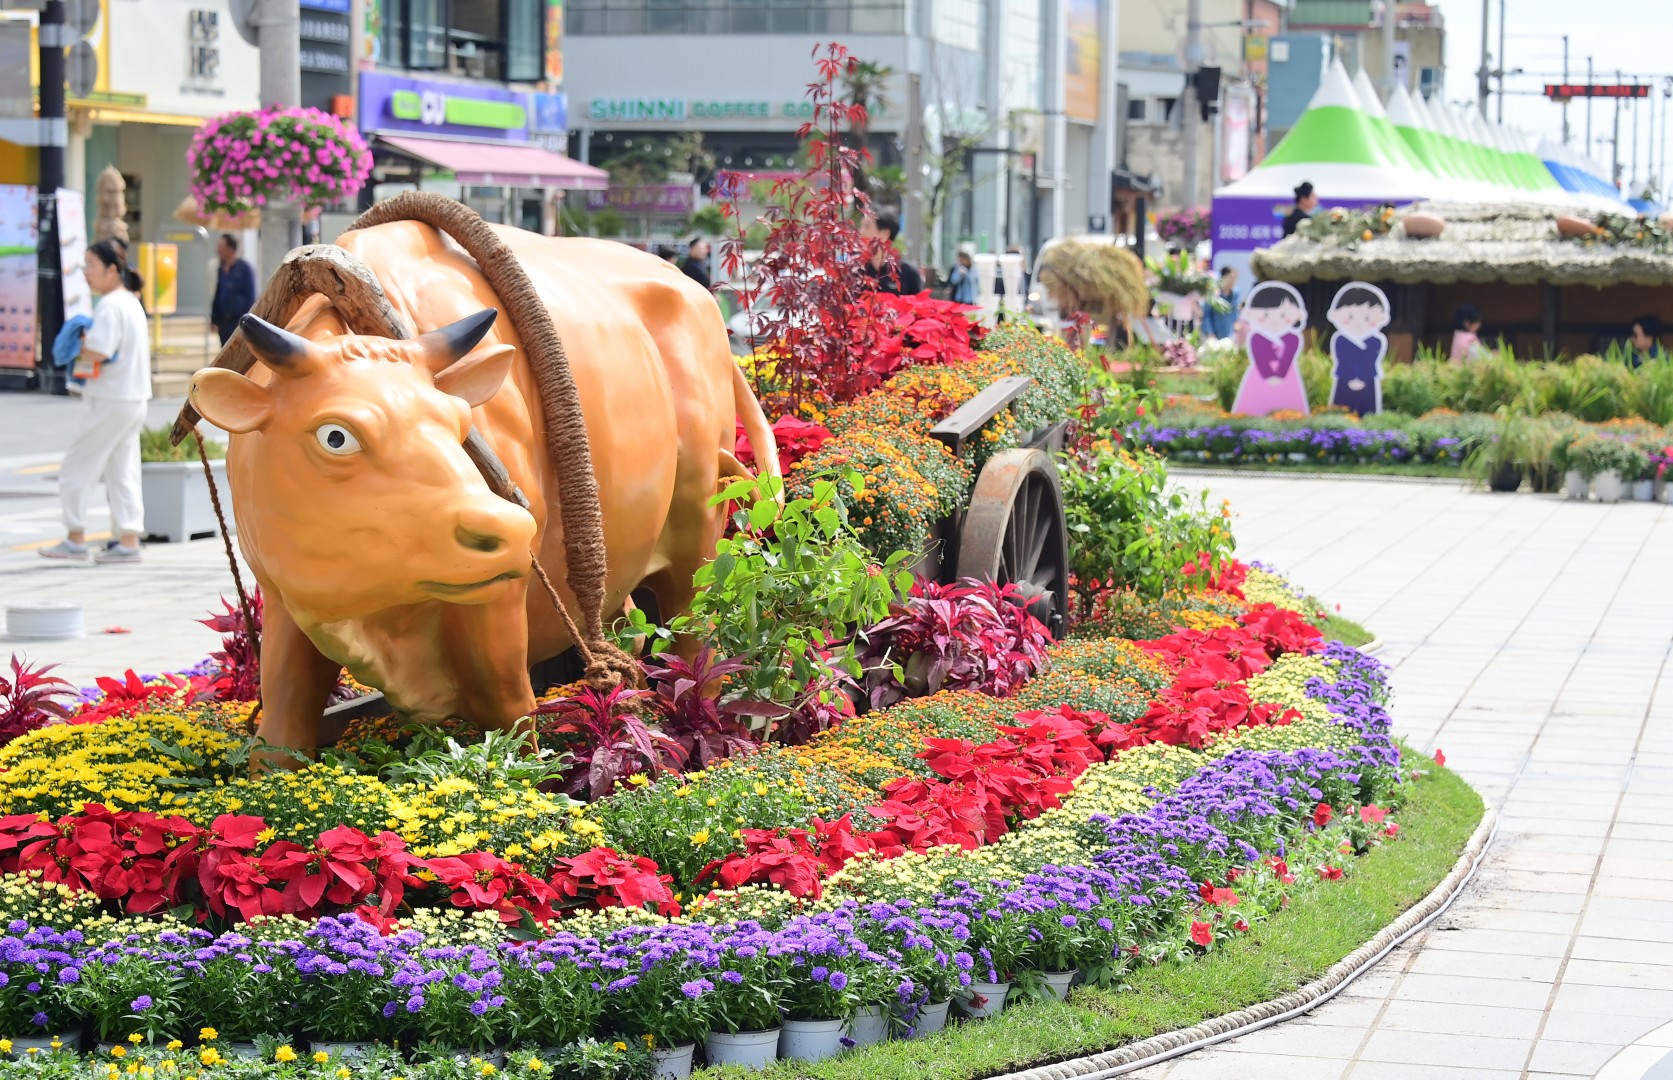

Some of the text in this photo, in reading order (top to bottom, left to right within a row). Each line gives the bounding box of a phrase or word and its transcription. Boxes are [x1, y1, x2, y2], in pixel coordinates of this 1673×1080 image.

[422, 90, 446, 125] CU
[591, 99, 684, 120] SHINNI
[692, 101, 770, 118] COFFEE
[1218, 224, 1249, 239] 2030
